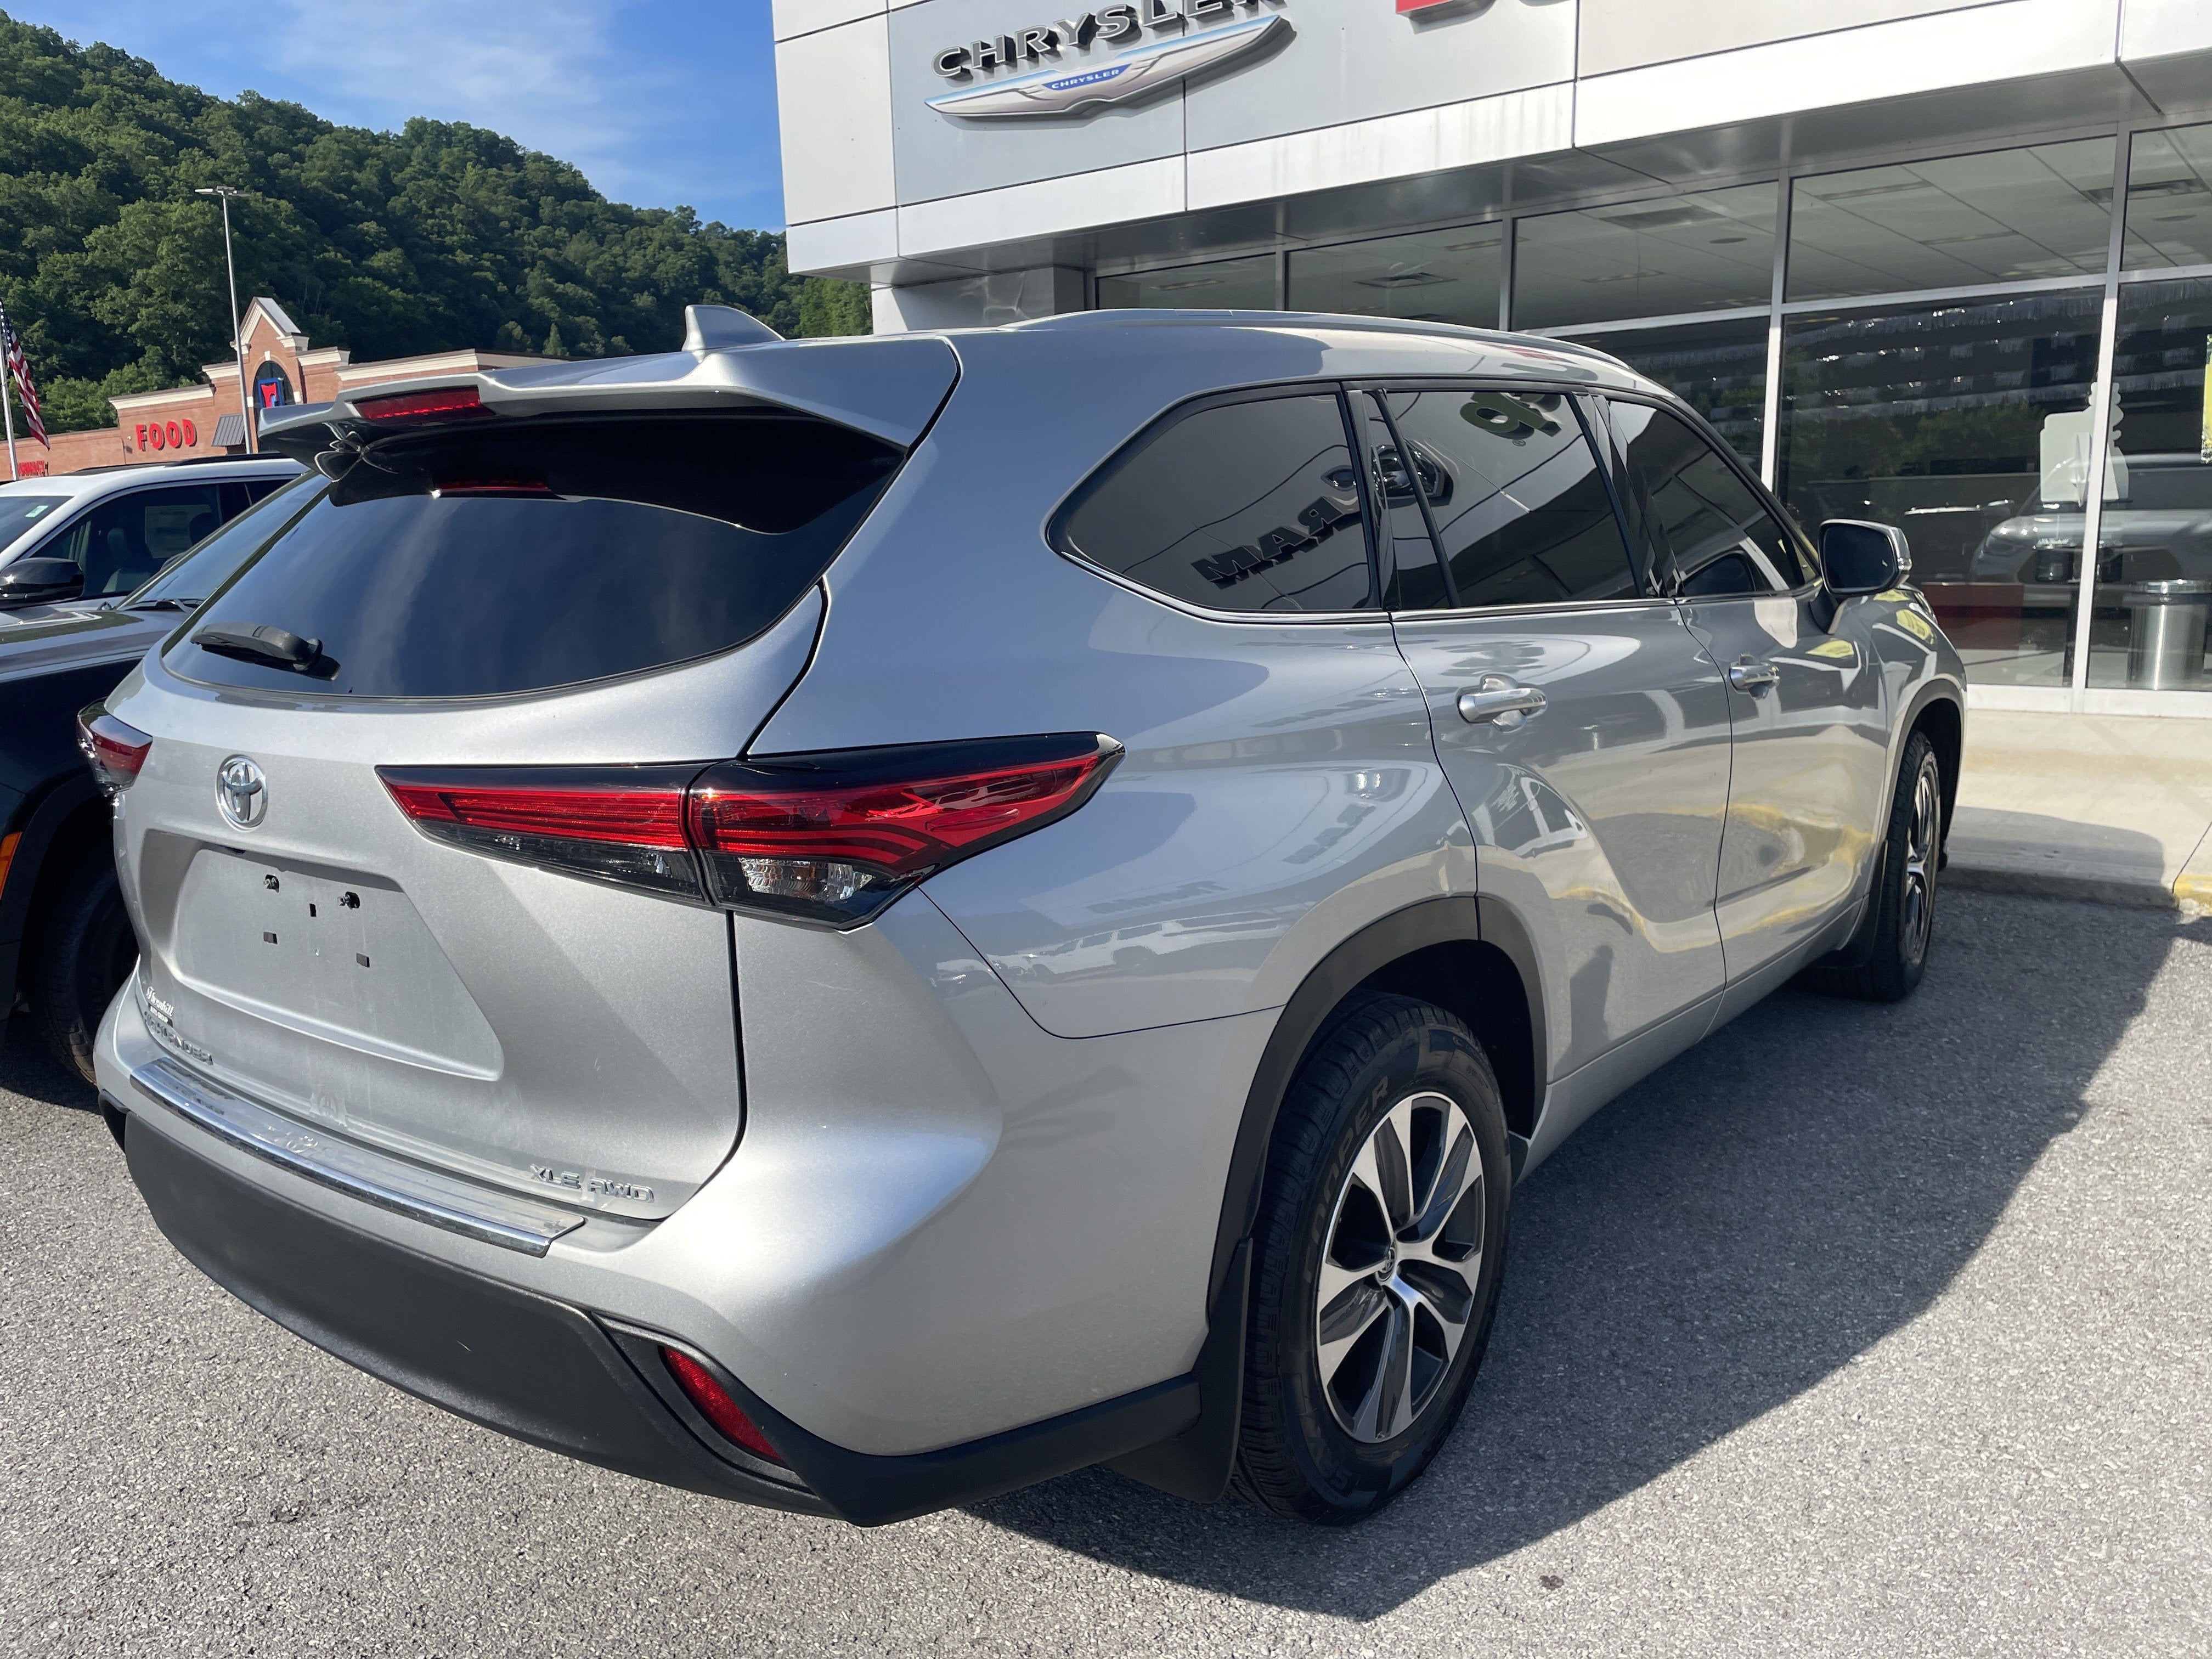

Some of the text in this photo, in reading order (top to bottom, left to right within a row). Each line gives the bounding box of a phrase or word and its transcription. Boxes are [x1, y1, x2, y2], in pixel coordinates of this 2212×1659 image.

[932, 0, 1247, 77] CHRYSL
[1051, 69, 1120, 88] CHRYSLER
[136, 419, 196, 451] FOOD
[529, 1164, 655, 1204] XLE AWD
